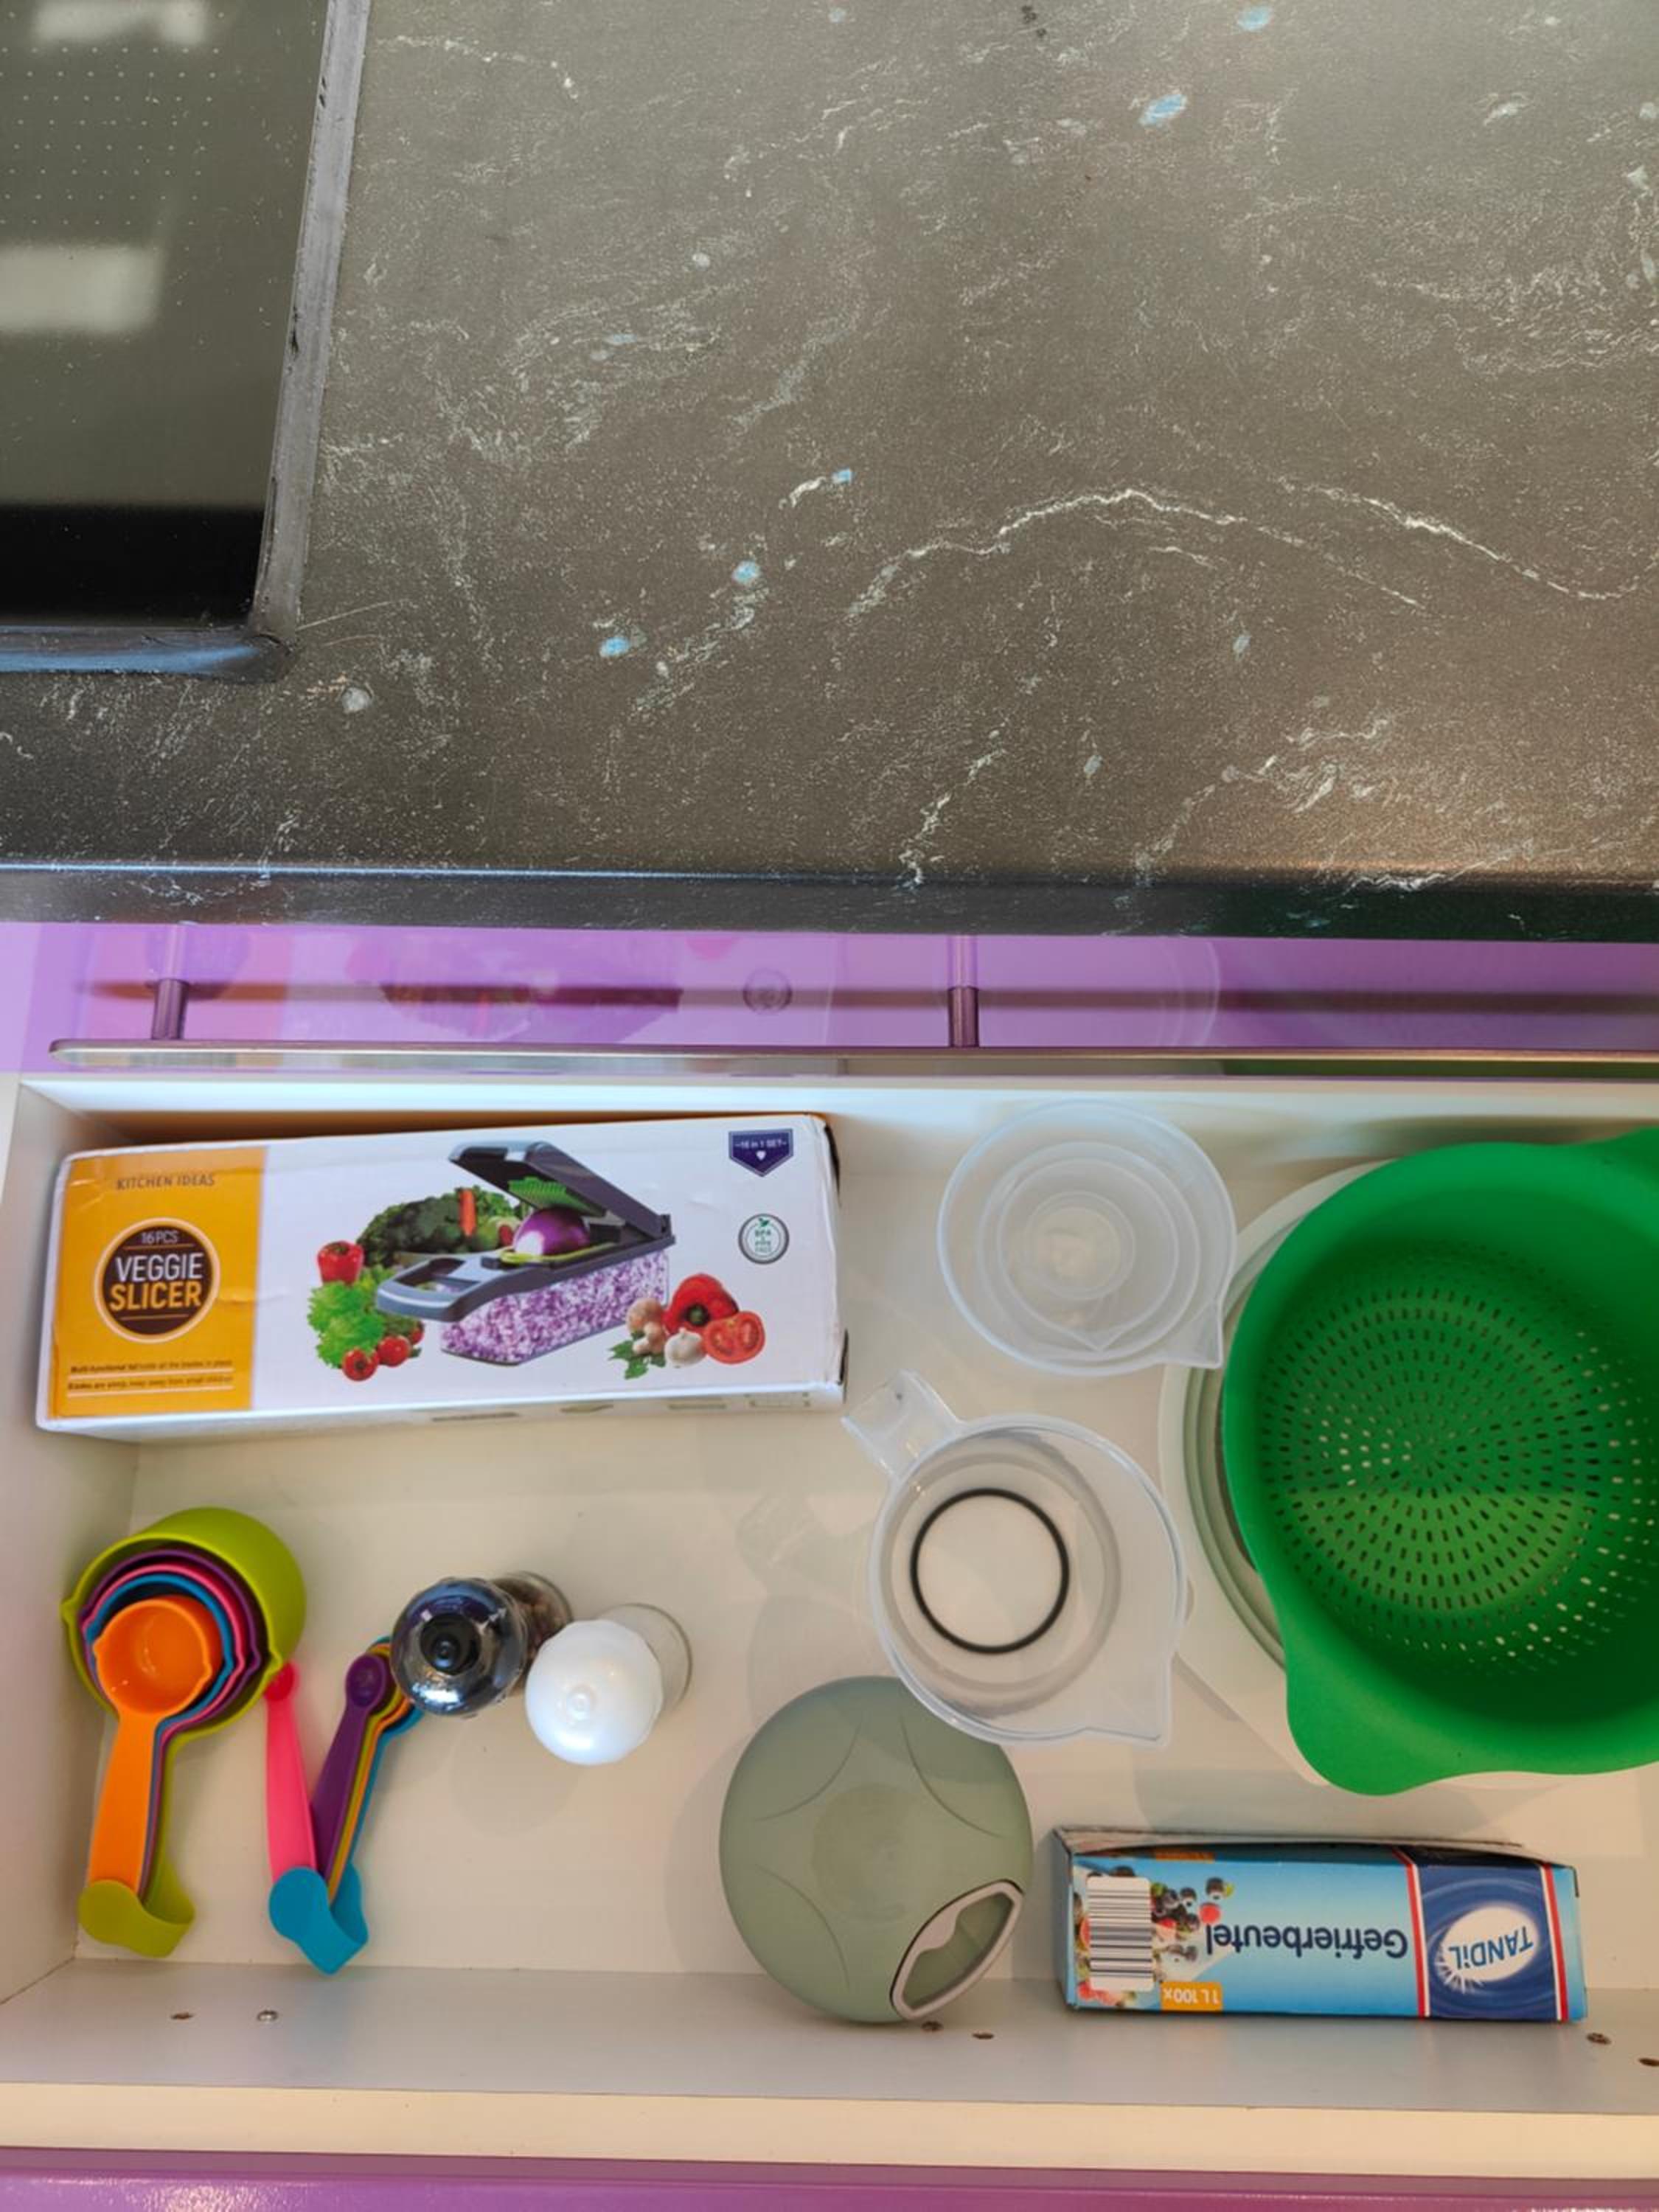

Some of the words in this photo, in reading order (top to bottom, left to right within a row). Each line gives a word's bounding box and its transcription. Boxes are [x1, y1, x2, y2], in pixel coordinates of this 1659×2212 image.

[116, 1175, 173, 1190] KITCHEN
[177, 1172, 215, 1187] IDEAS
[116, 1252, 204, 1283] VEGGIE
[109, 1280, 201, 1311] SLICER
[1205, 1922, 1408, 1958] Gefrierbeutel
